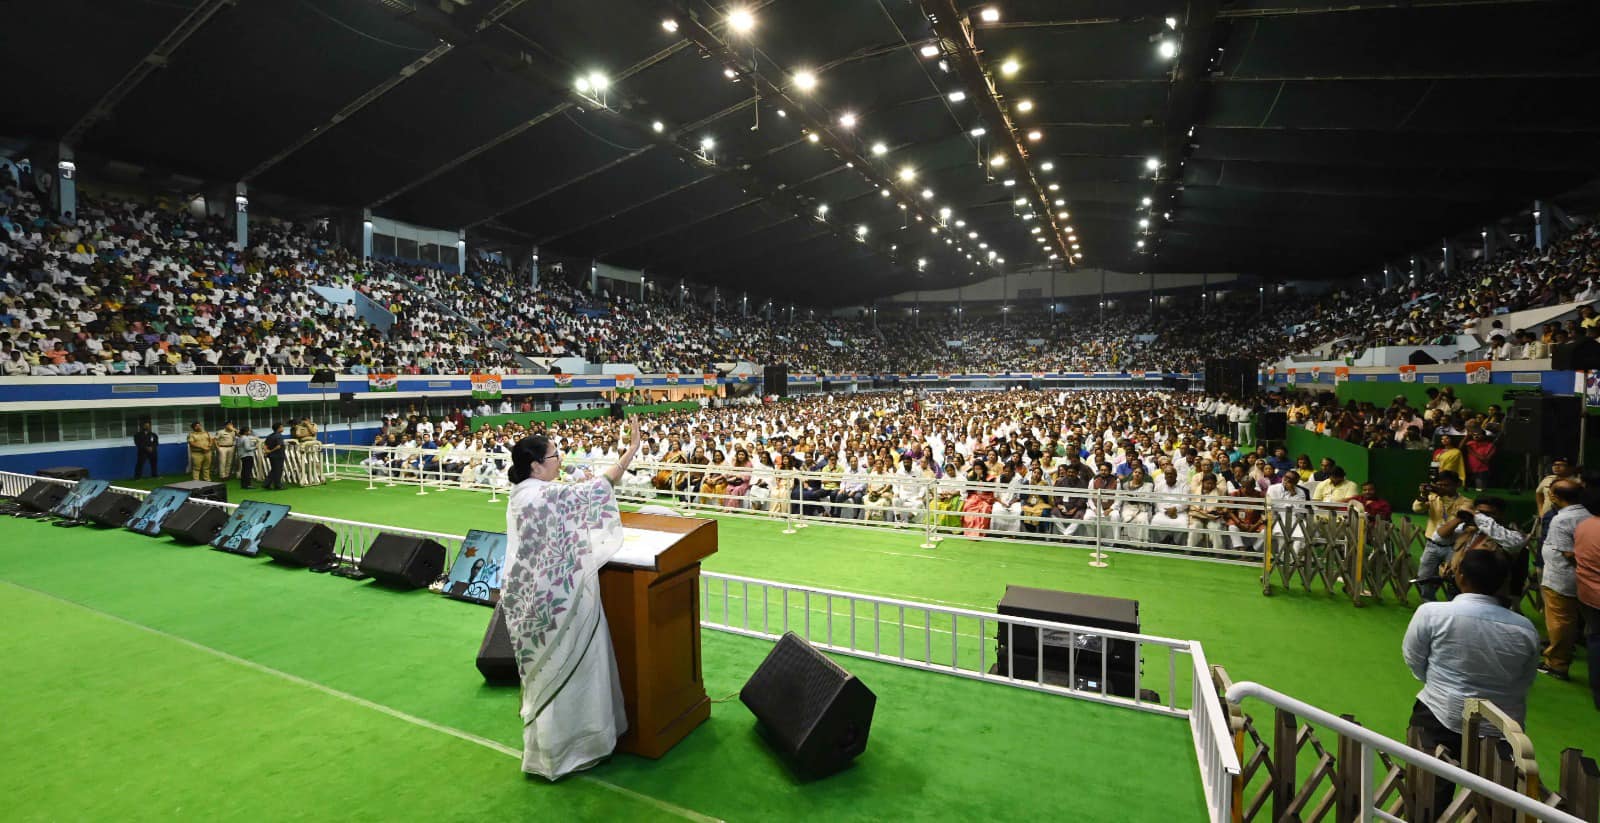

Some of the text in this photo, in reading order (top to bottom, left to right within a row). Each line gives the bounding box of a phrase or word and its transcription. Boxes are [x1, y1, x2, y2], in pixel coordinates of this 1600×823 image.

[63, 169, 71, 179] J
[239, 204, 246, 212] K
[230, 386, 241, 395] M
